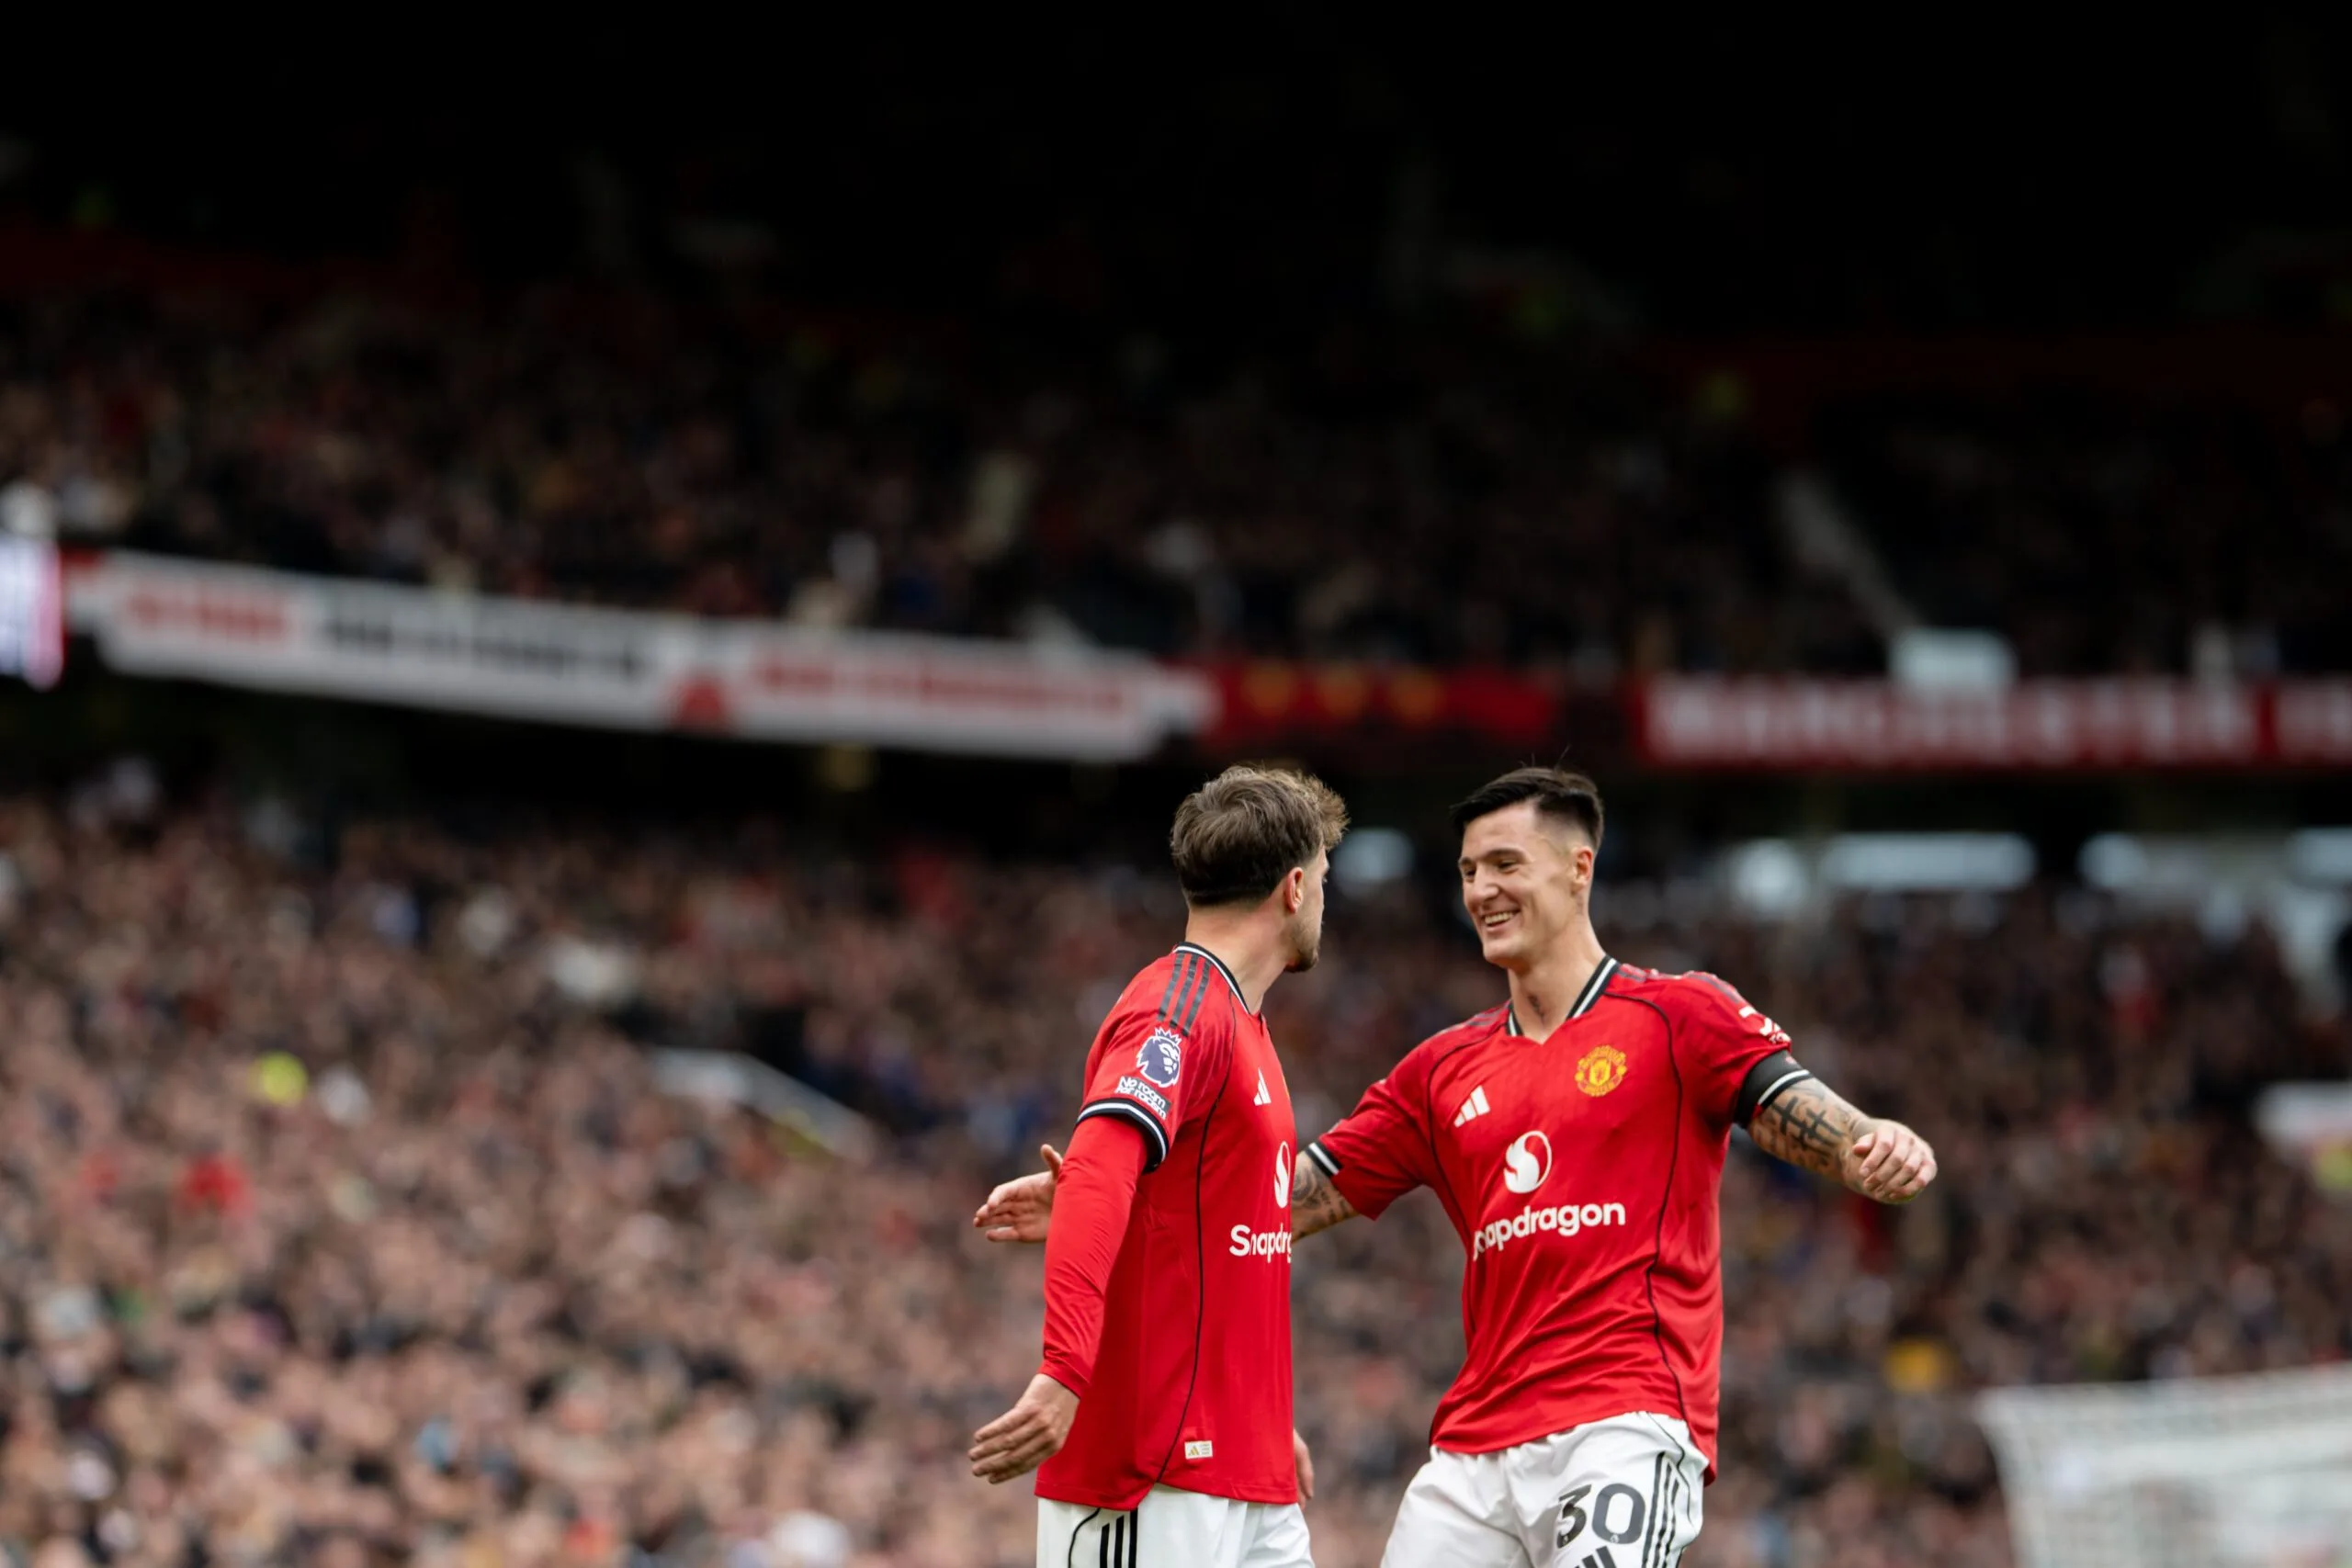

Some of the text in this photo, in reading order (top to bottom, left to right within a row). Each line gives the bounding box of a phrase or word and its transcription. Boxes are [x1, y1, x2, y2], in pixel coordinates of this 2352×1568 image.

[1119, 1076, 1166, 1110] No room
[1473, 1202, 1625, 1262] napdragon
[1556, 1483, 1646, 1549] 30
